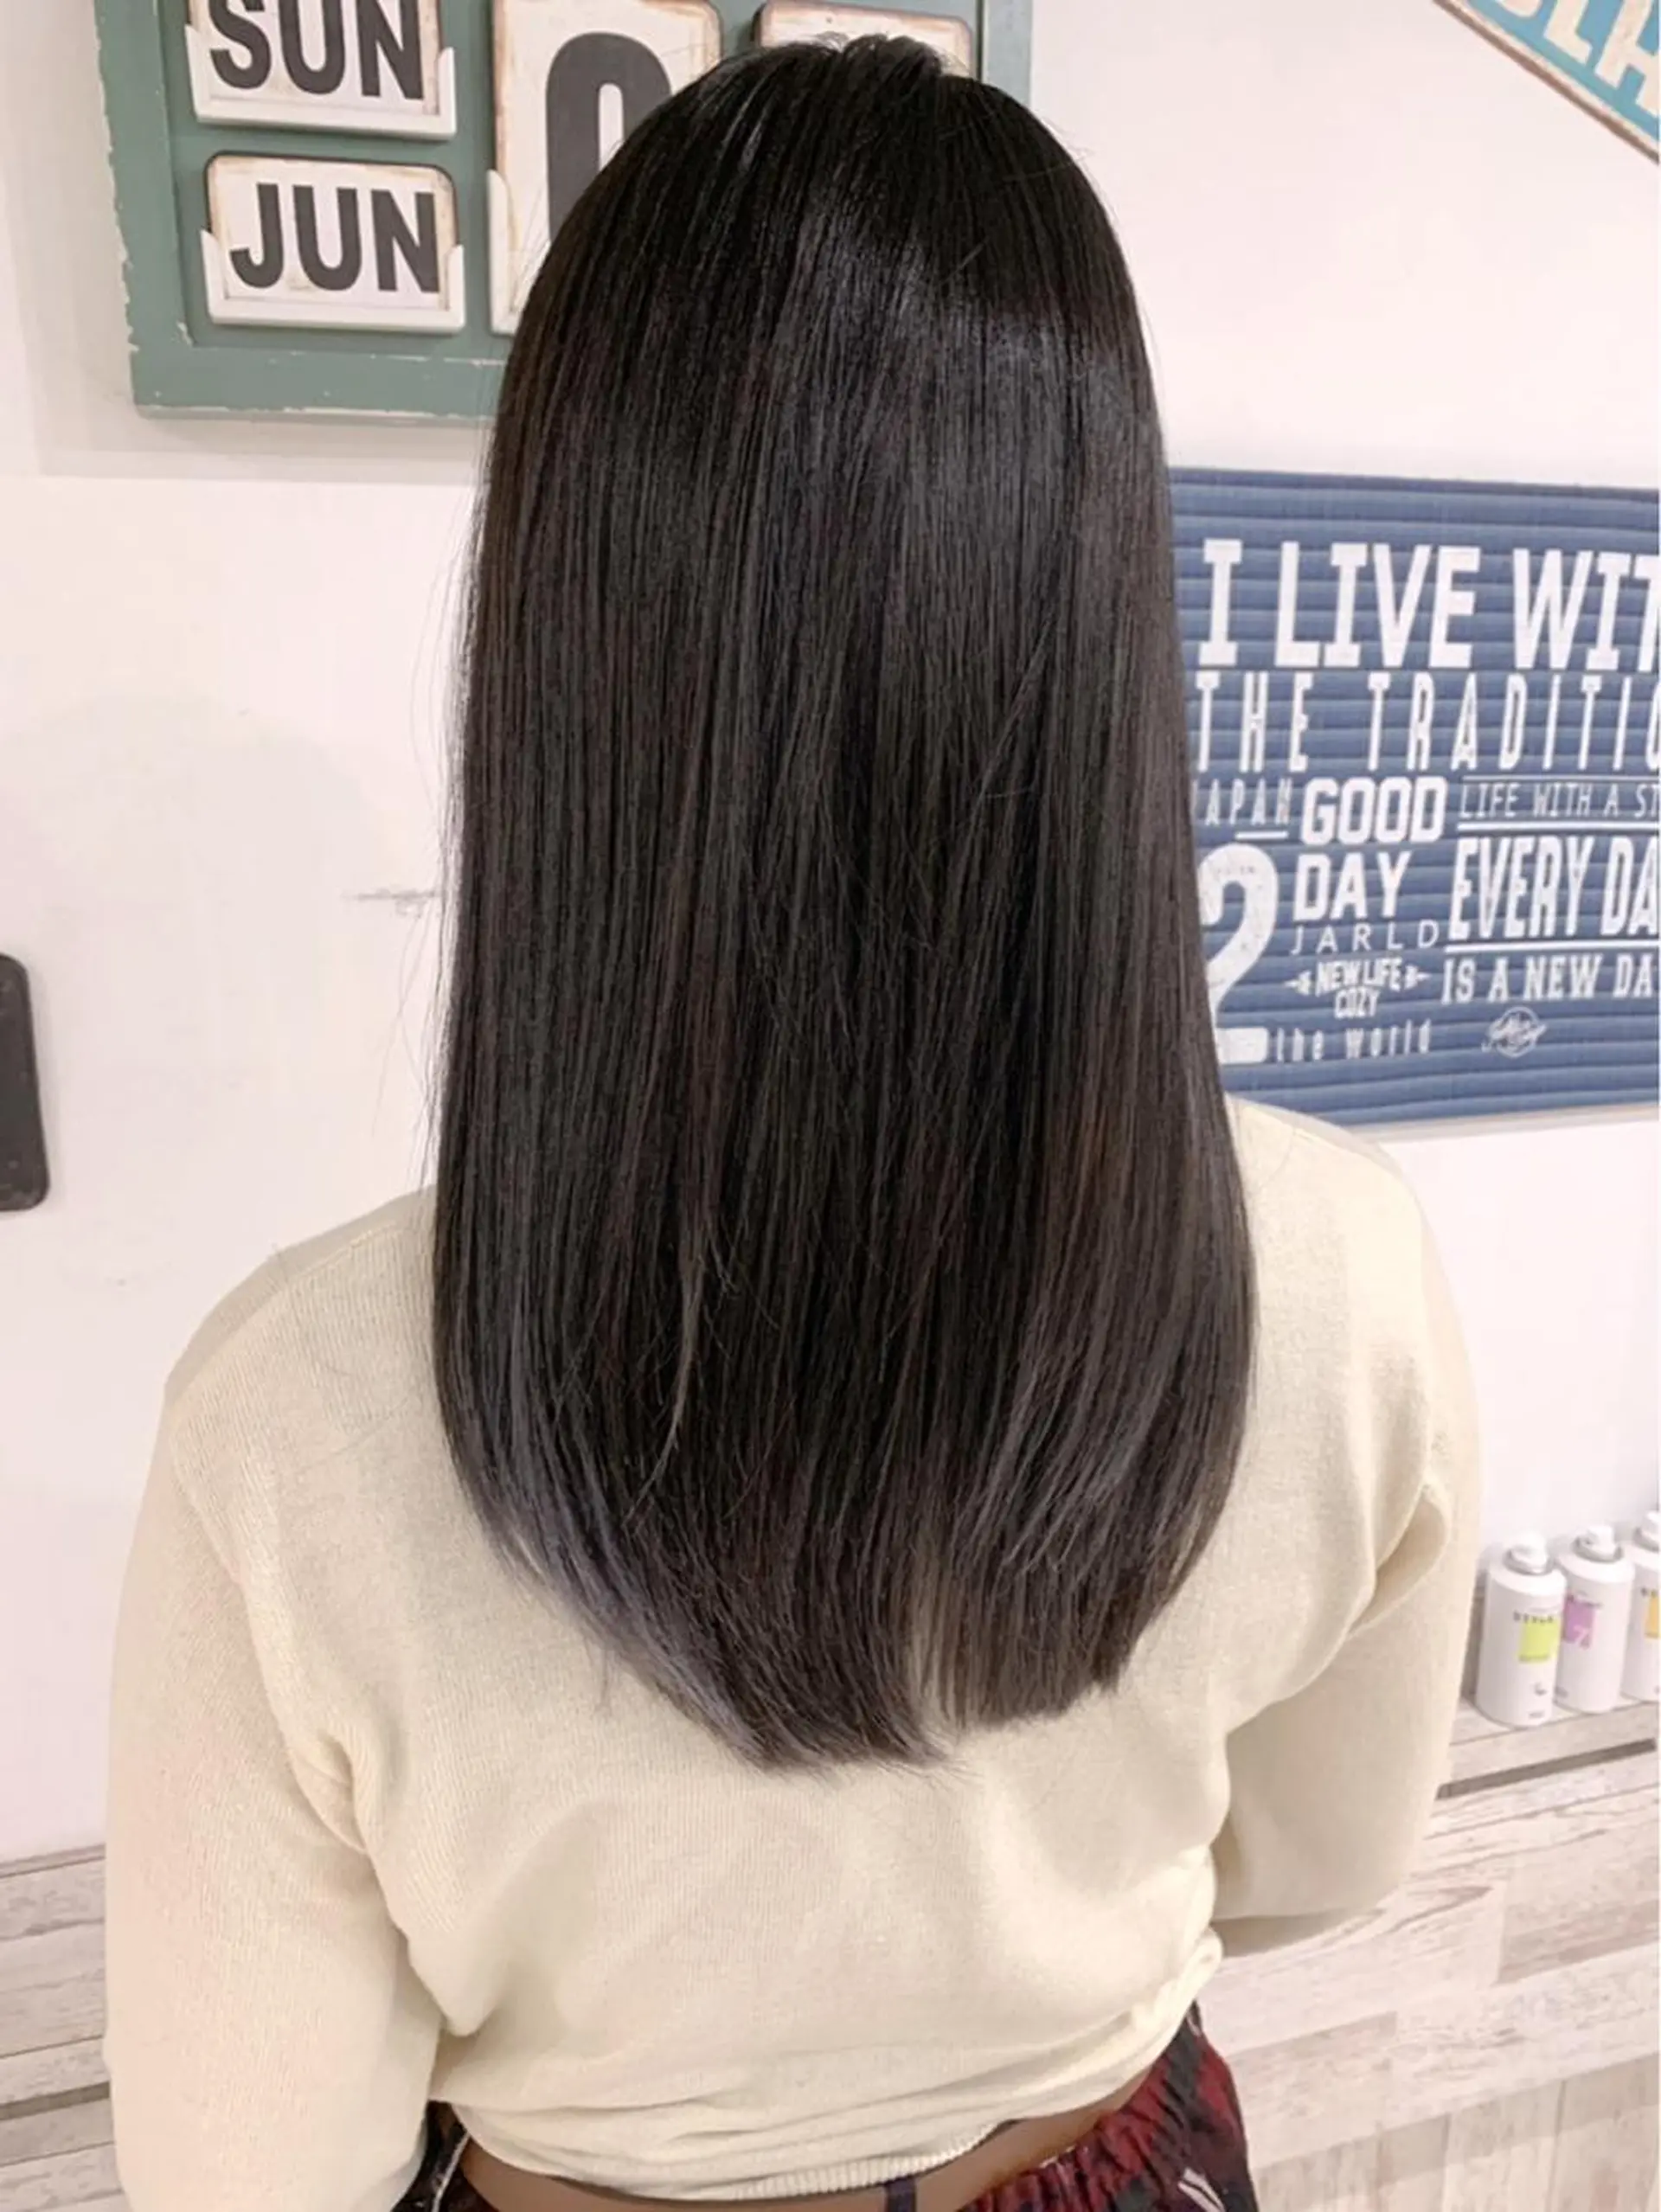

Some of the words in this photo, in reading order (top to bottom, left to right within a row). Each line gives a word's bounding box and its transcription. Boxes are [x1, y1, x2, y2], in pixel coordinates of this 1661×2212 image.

[208, 0, 424, 100] SUN
[230, 183, 440, 293] JUN
[1198, 538, 1242, 666] I
[1275, 541, 1480, 668] LIVE
[1196, 670, 1313, 773] THE
[1300, 776, 1448, 845] GOOD
[1459, 782, 1521, 818] LIFE
[1532, 782, 1593, 817] WITH
[1602, 783, 1619, 817] A
[1292, 850, 1412, 921] DAY
[1448, 836, 1595, 940] EVERY
[1600, 836, 1658, 936] DA
[1196, 842, 1279, 1065] 2
[1290, 919, 1440, 955] JARLD
[1314, 959, 1362, 997] NEW
[1363, 956, 1402, 992] LIFE
[1441, 957, 1476, 1005] IS
[1488, 956, 1509, 1002] A
[1523, 953, 1603, 1001] NEW
[1613, 952, 1653, 1000] DA
